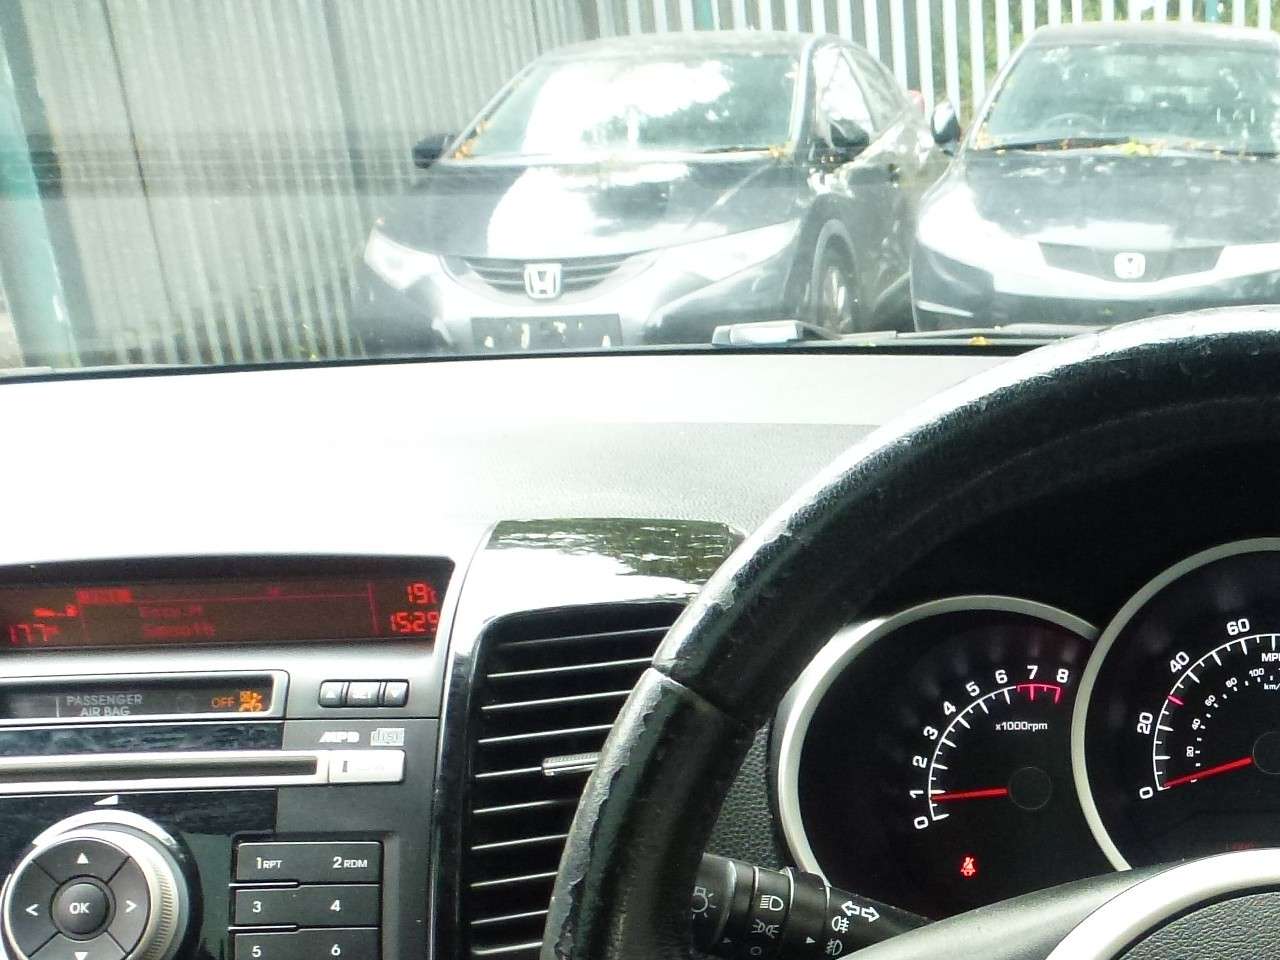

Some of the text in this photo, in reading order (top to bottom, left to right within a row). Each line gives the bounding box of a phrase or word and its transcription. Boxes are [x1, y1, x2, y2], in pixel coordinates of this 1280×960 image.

[1227, 618, 1250, 636] 60
[1169, 651, 1190, 674] 40
[995, 670, 1008, 684] 6
[1027, 665, 1038, 679] 7
[1056, 668, 1069, 683] 8
[966, 681, 980, 697] 5
[66, 694, 143, 706] PASSENGER
[211, 697, 235, 709] OFF
[79, 706, 131, 717] AIR BAG
[942, 701, 957, 716] 4
[1136, 712, 1153, 735] 20
[923, 725, 938, 740] 3
[912, 755, 927, 768] 2
[909, 789, 924, 798] 1
[1139, 787, 1153, 800] 0
[913, 816, 928, 830] 0
[69, 902, 90, 915] OK
[252, 901, 262, 914] 3
[330, 900, 341, 912] 4
[252, 946, 262, 959] 5
[331, 944, 341, 957] 6
